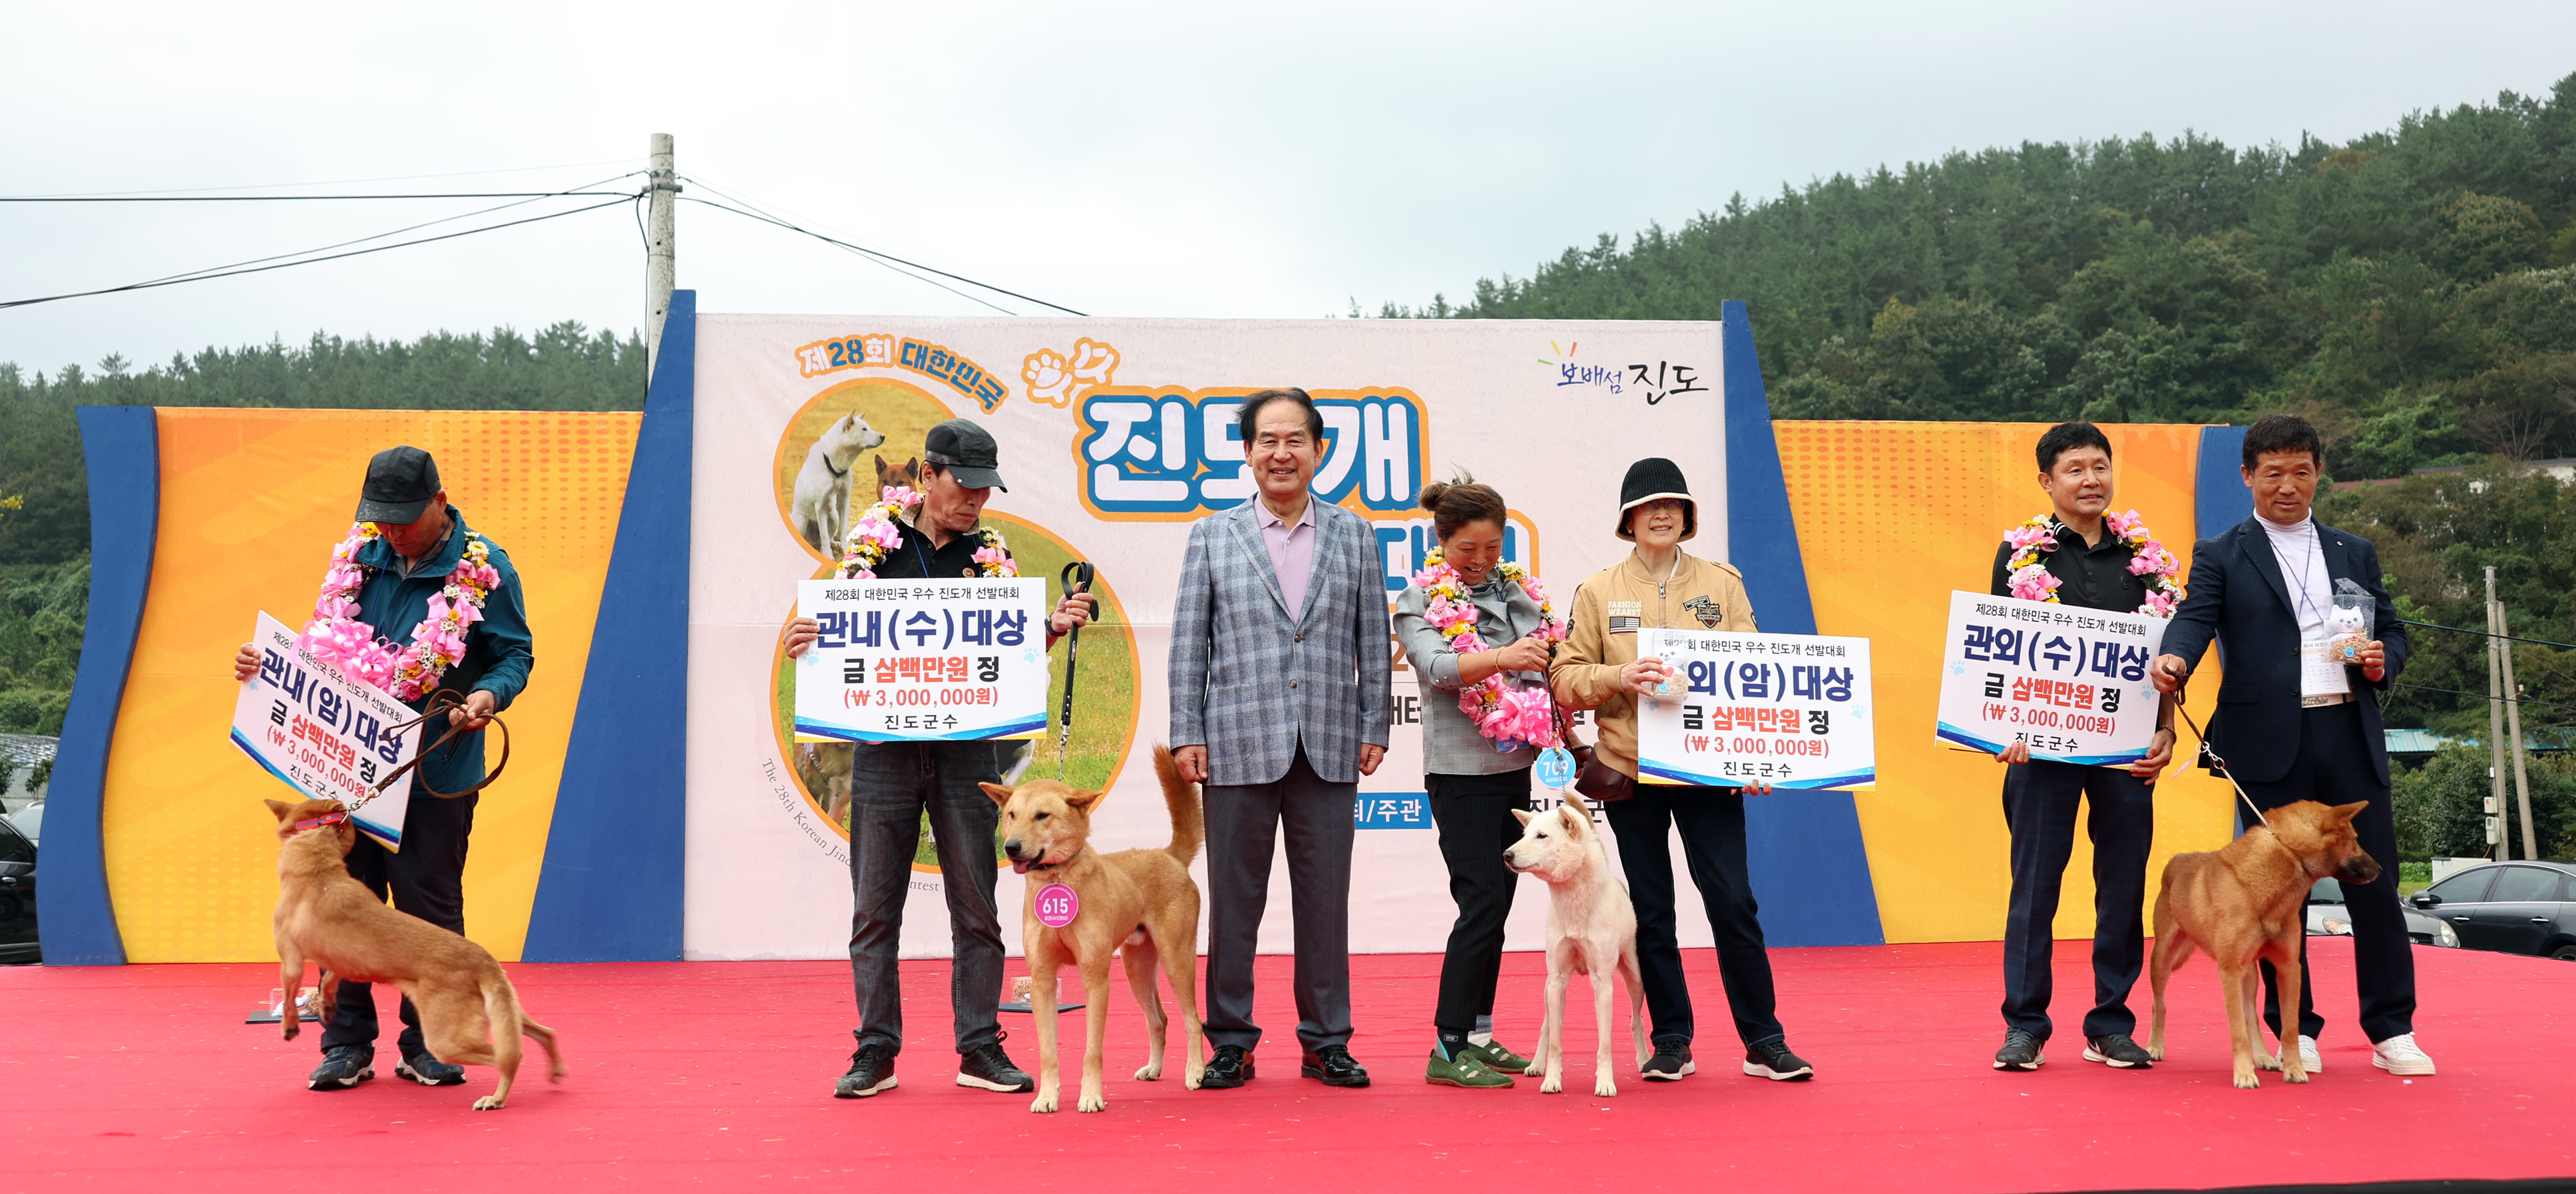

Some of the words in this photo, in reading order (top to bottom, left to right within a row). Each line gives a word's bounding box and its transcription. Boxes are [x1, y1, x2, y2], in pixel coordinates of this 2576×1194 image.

[799, 337, 892, 374] 제28회
[900, 342, 1004, 410] 대한민국
[1557, 363, 1623, 395] 보배섬
[1628, 361, 1709, 405] 진도
[825, 588, 860, 601] 제28회
[865, 588, 909, 600] 대한민국
[913, 588, 935, 600] 우수
[939, 587, 971, 599] 진도개
[976, 587, 1020, 599] 선발대회
[816, 609, 1027, 650] 관내(수)대상
[1976, 604, 2008, 618] 제28회
[2012, 608, 2050, 624] 대한민국
[2053, 613, 2073, 626] 우수
[2077, 616, 2105, 631] 진도개
[2109, 620, 2147, 636] 선발대회
[1701, 640, 1741, 653] 대한민국
[1745, 642, 1766, 654] 우수
[1770, 643, 1801, 655] 진도개
[1805, 644, 1845, 657] 선발대회
[1964, 624, 2149, 681] 관외(수)대상
[843, 658, 865, 684] 금
[874, 656, 968, 682] 삼백만원
[977, 656, 999, 682] 정
[1688, 660, 1853, 701] 외(암)대상
[260, 647, 403, 764] 관내(암)대상
[329, 669, 344, 685] 우수
[371, 699, 403, 724] 선발대회
[1985, 672, 2004, 698] 금
[2012, 676, 2094, 709] 삼백만원
[2101, 687, 2121, 713] 정
[885, 714, 958, 729] 진도군수
[1683, 705, 1703, 729] 금
[1711, 706, 1800, 733] 삼백만원
[1808, 710, 1829, 735] 정
[271, 699, 288, 727] 금
[292, 713, 355, 771] 삼백만원
[360, 757, 377, 783] 정
[1543, 760, 1570, 777] 709
[1723, 761, 1792, 777] 진도군수
[762, 758, 777, 783] The
[774, 784, 795, 813] 28th
[793, 811, 827, 849] Korean
[1042, 898, 1069, 914] 615
